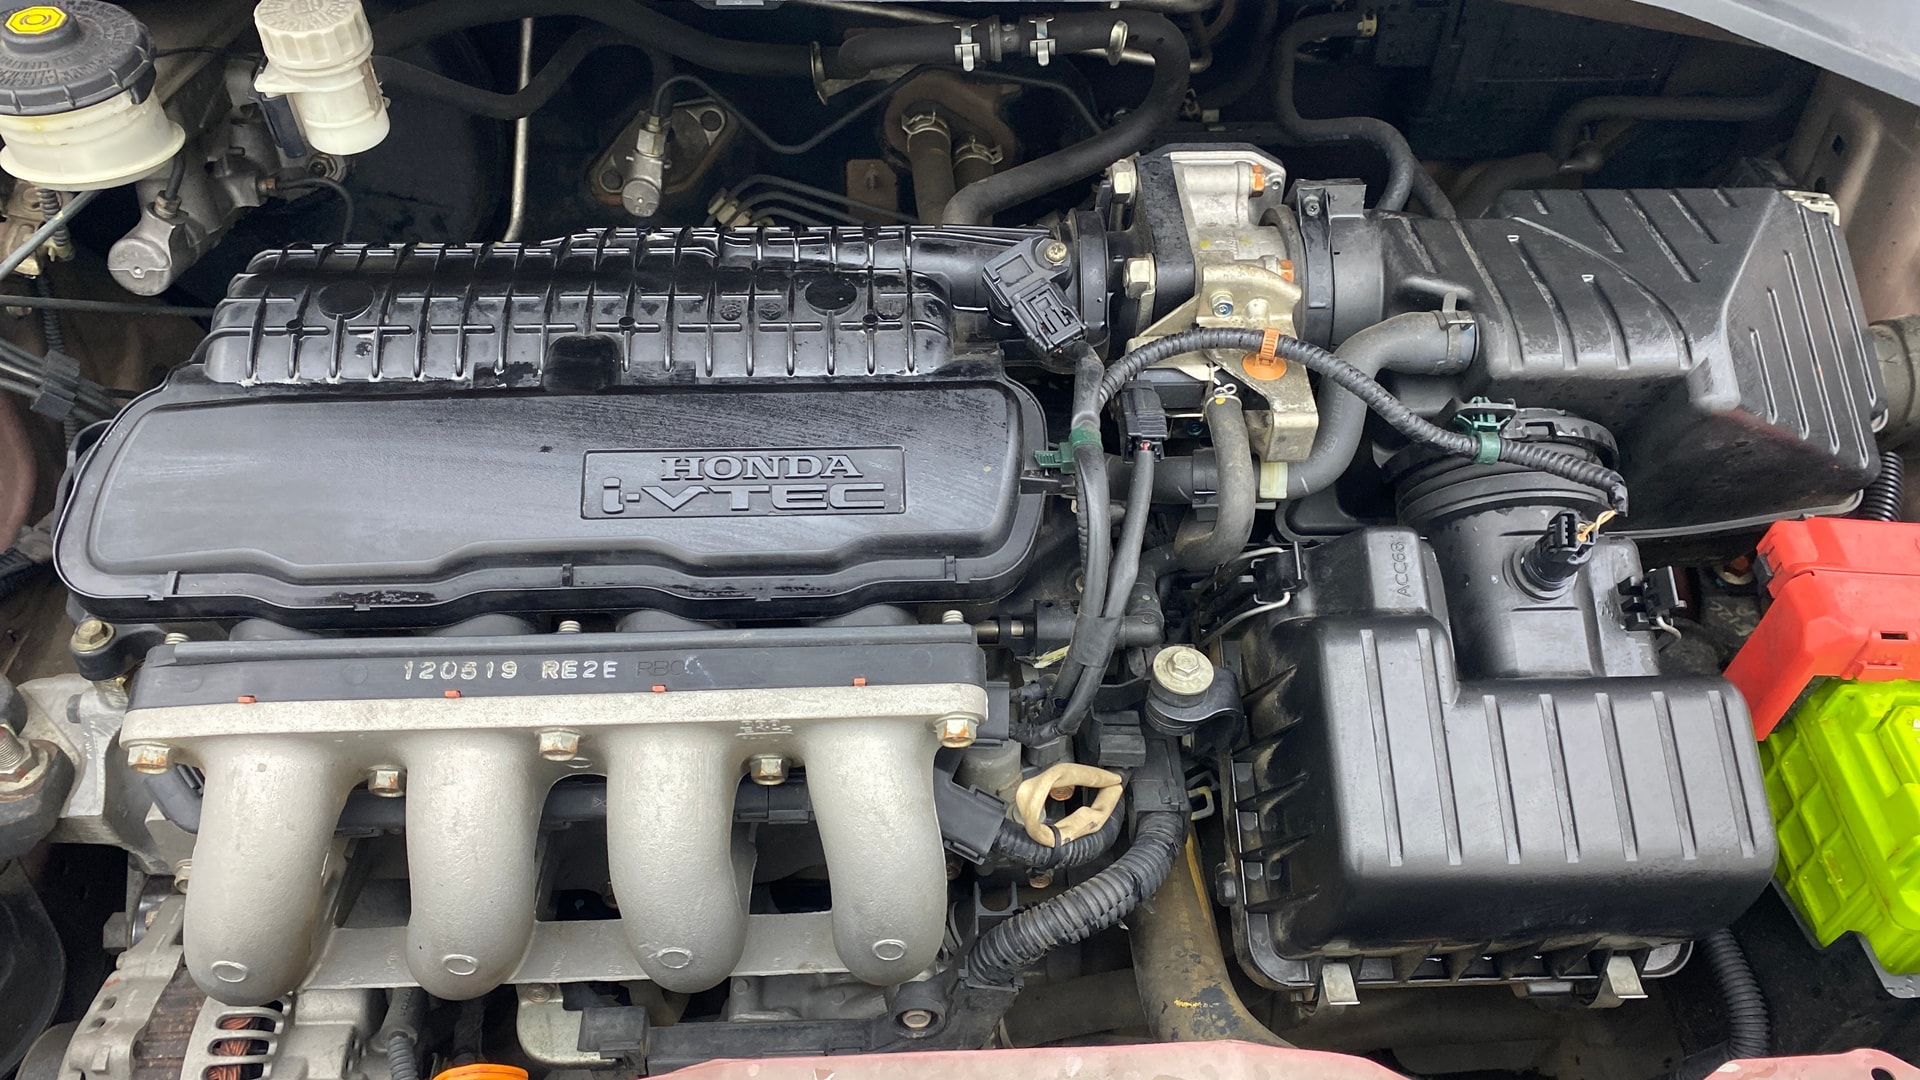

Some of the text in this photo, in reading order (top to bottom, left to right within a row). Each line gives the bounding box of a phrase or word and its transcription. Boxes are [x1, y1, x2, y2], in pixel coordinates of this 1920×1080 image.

[661, 454, 865, 481] HONDA
[602, 476, 886, 514] i-VTEC
[403, 660, 518, 681] 120519
[541, 660, 619, 680] RE2E
